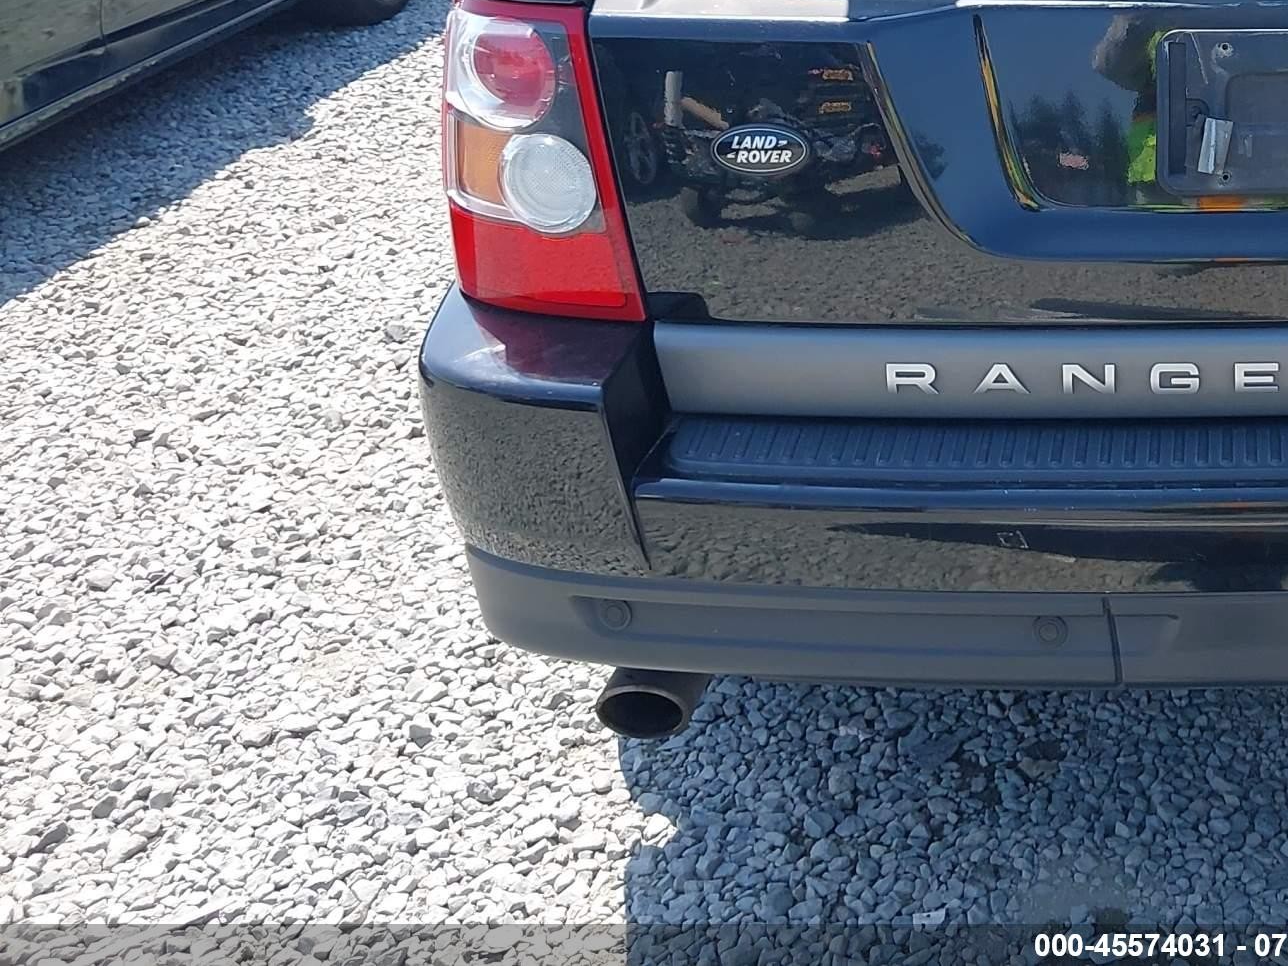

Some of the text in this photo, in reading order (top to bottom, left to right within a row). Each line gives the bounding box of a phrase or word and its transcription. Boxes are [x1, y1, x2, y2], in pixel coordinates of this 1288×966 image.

[731, 135, 777, 150] LAND
[736, 149, 792, 164] ROVER
[885, 361, 1280, 395] RANGE
